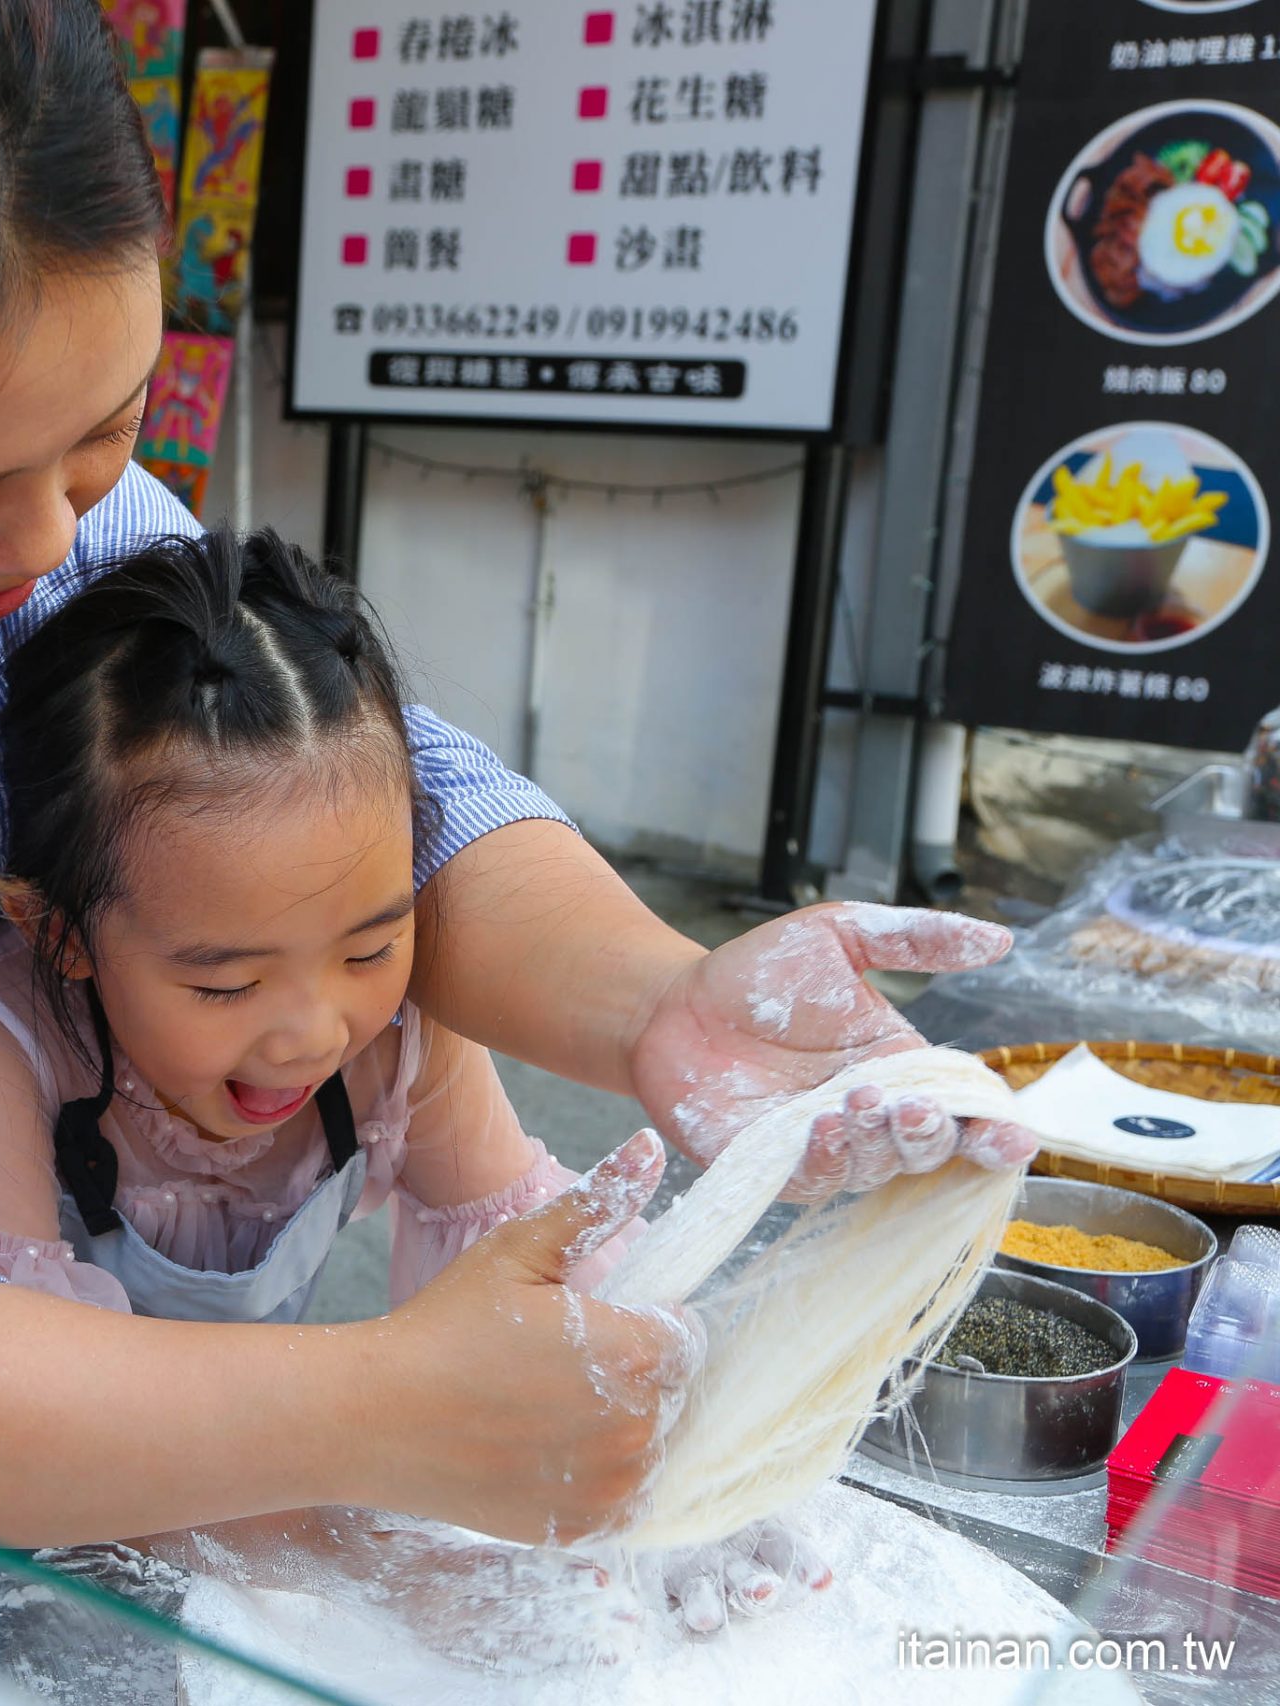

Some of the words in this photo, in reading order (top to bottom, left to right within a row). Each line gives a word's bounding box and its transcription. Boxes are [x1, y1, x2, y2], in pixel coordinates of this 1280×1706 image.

[632, 0, 773, 47] 冰淇淋
[630, 72, 767, 124] 花生糖
[619, 147, 821, 198] 甜點/飲料
[384, 228, 460, 271] 簡餐
[615, 225, 702, 271] 沙畫
[1189, 368, 1227, 394] 80
[1173, 676, 1209, 701] 80
